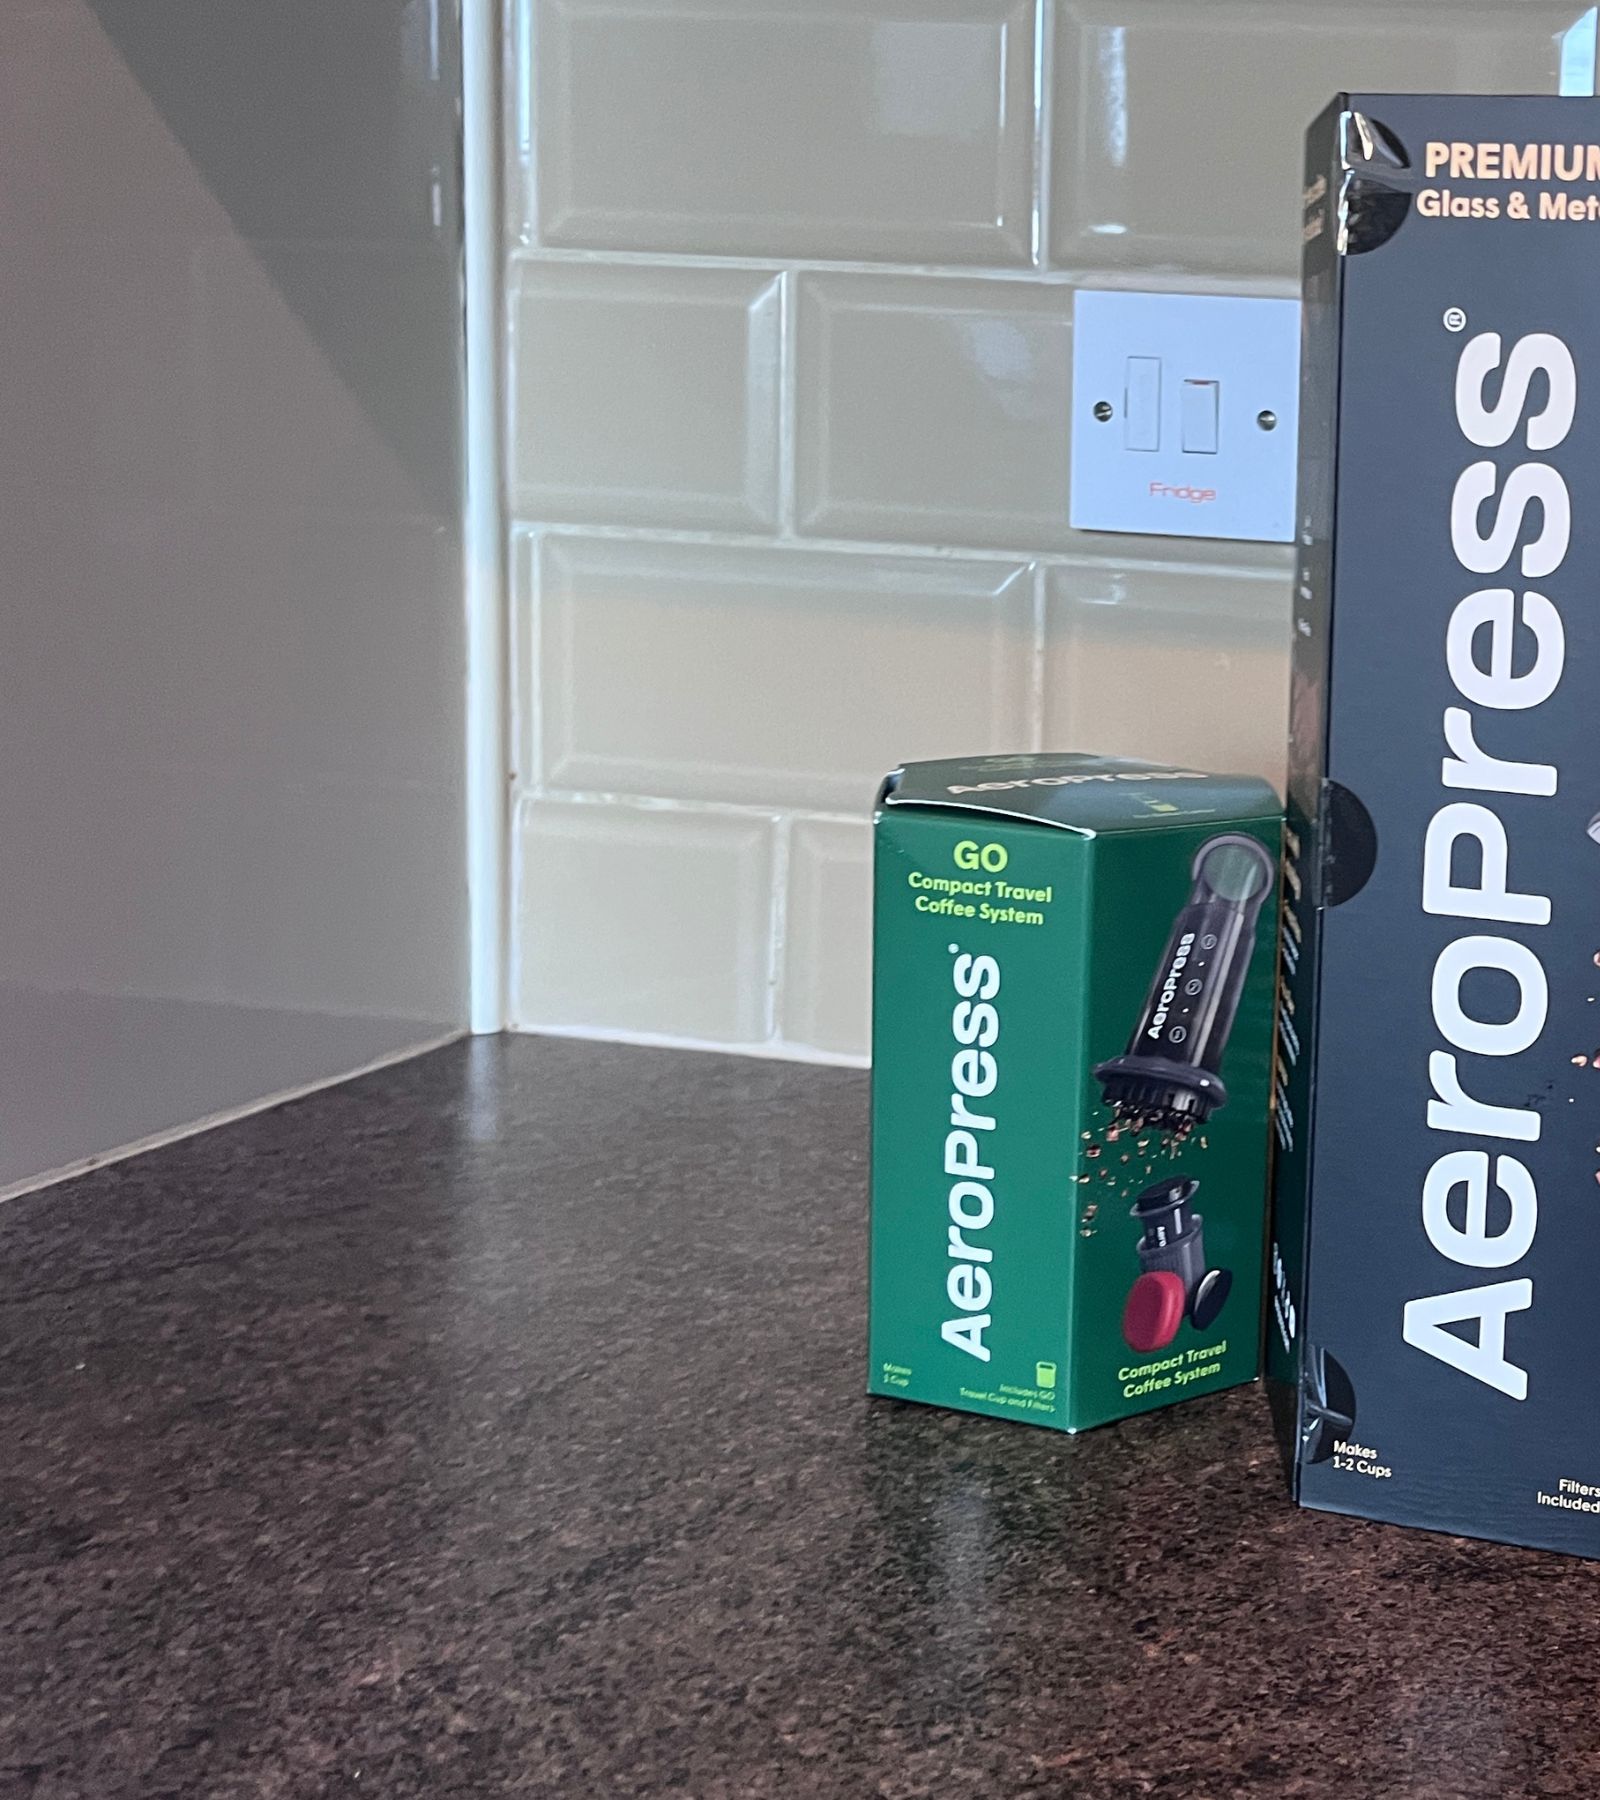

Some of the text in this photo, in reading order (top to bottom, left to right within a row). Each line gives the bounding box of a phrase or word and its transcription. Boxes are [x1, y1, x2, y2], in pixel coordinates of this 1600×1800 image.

[1416, 190, 1500, 218] Glass
[1507, 191, 1531, 220] &
[1149, 481, 1217, 503] Fridge
[953, 840, 1008, 873] GO
[908, 871, 1052, 903] Compact Travel
[914, 895, 1044, 925] Coffee System
[941, 952, 1001, 1362] AeroPress
[1118, 1339, 1227, 1381] Compact Travel
[1123, 1362, 1221, 1398] Coffee System
[1333, 1440, 1378, 1460] Makes
[1333, 1456, 1393, 1479] 1-2 Cups
